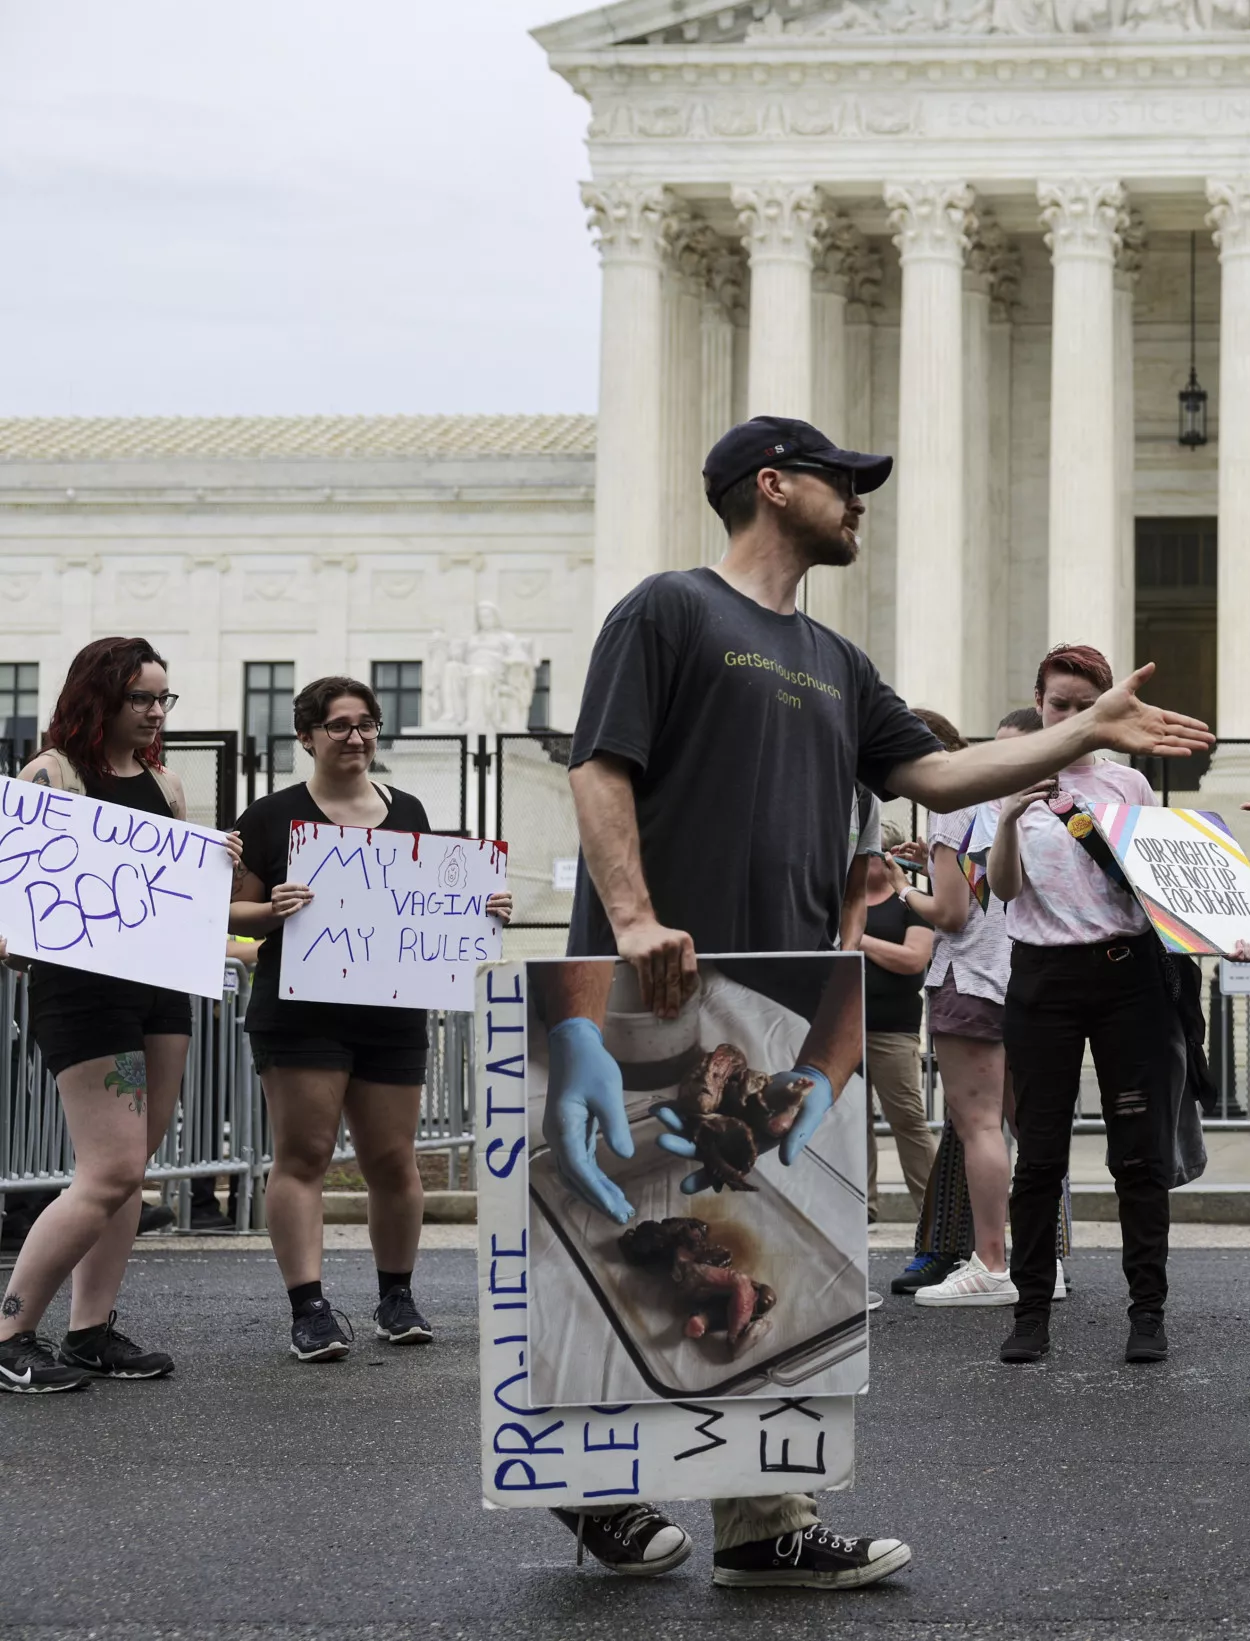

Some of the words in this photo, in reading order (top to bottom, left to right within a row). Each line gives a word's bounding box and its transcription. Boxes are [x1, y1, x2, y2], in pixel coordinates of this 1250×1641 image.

[724, 651, 842, 700] GetSeriousChurch
[2, 781, 74, 830] WE
[93, 805, 228, 868] WONT
[0, 827, 79, 884] GO
[306, 846, 397, 890] MY
[1133, 838, 1173, 864] OUR
[1163, 838, 1230, 868] RIGHTS
[1150, 864, 1188, 889] ARE
[1180, 866, 1217, 890] NOT
[1212, 867, 1237, 891] UP
[25, 863, 193, 952] BACK
[1161, 887, 1203, 915] FOR
[303, 926, 375, 963] MY
[398, 927, 488, 963] RULES
